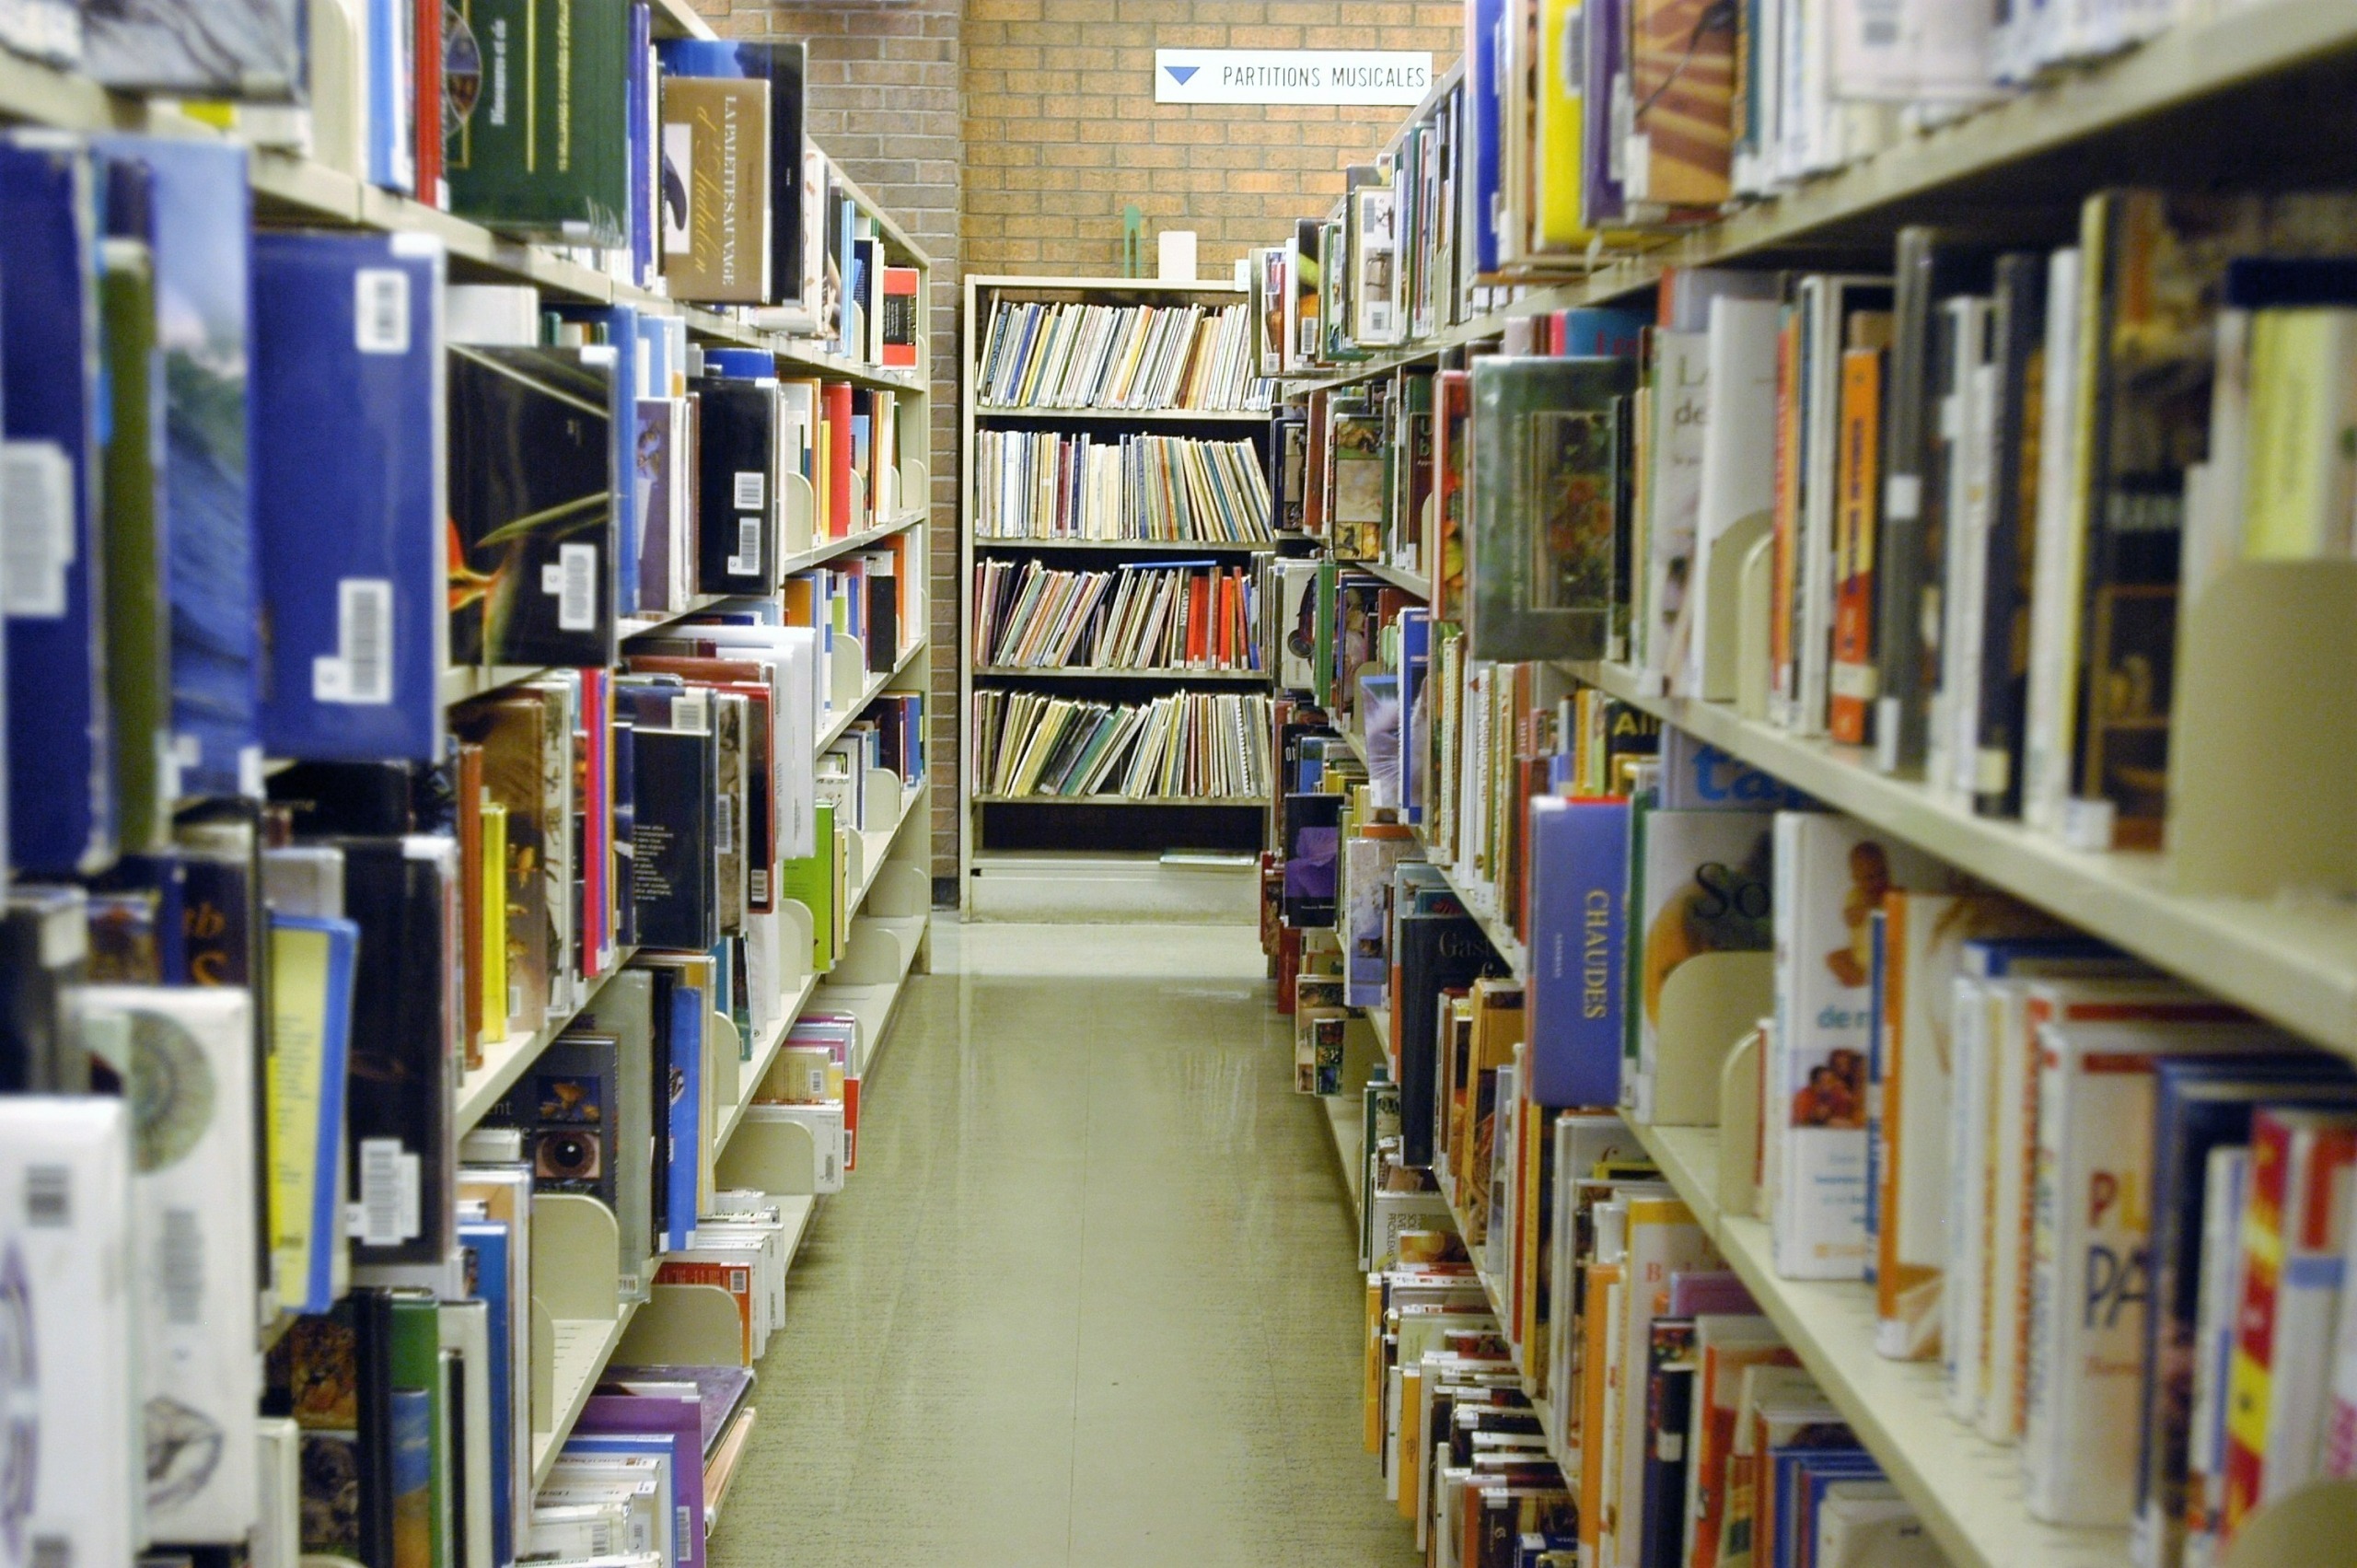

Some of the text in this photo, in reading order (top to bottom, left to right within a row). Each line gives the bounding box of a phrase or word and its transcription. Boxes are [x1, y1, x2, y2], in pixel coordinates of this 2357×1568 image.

[1223, 65, 1425, 88] PARTITIONS MUSICALES
[724, 123, 737, 198] PALETTE
[722, 201, 736, 286] SAUVAGE
[1582, 888, 1610, 1019] CHAUDES
